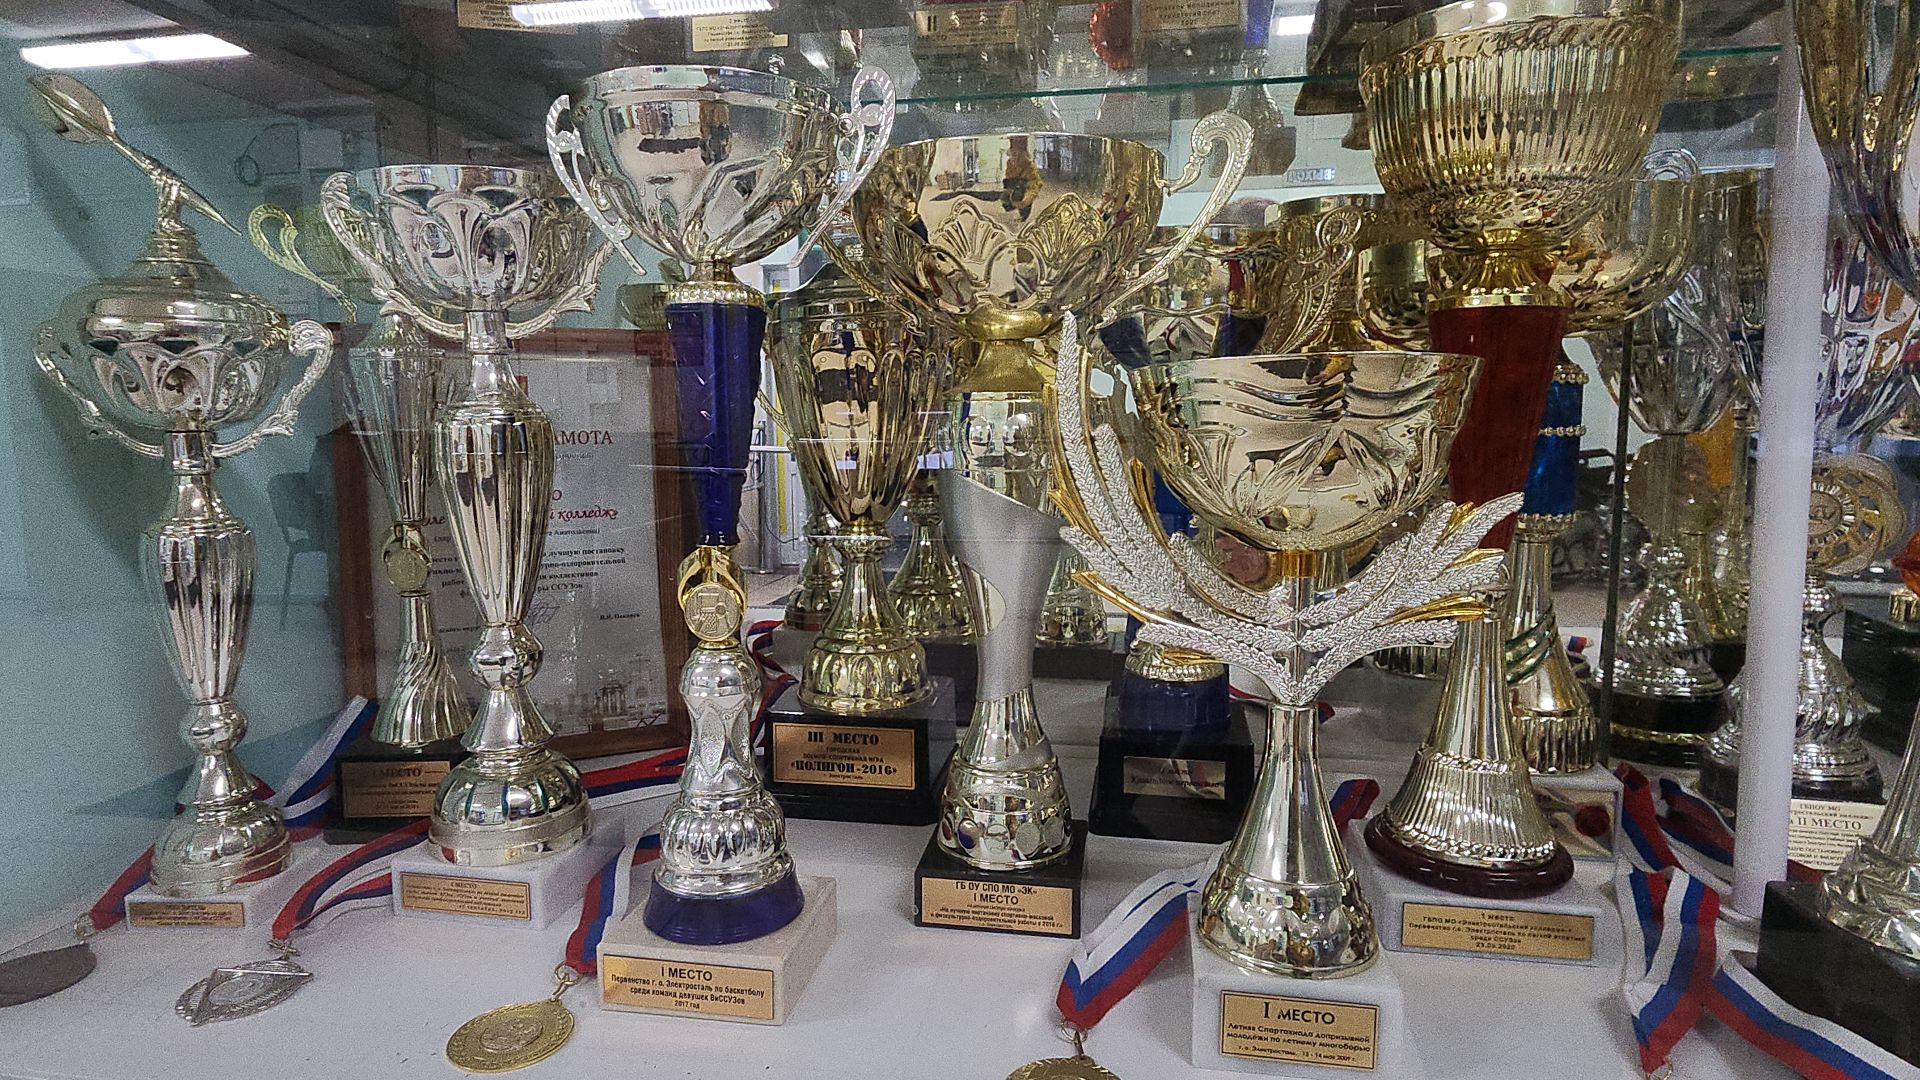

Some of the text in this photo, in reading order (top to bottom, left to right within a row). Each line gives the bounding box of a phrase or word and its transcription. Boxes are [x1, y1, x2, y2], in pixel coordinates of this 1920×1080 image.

[807, 731, 880, 746] III МЕСТО
[1798, 817, 1861, 830] II МЕСТО
[955, 881, 966, 890] ГБ
[968, 882, 980, 891] ОУ
[982, 883, 999, 892] СПО
[1001, 884, 1015, 894] МО
[980, 893, 1019, 905] МЕСТО
[668, 967, 713, 982] МЕСТО
[611, 974, 650, 985] Первенство
[665, 979, 713, 992] Электросталь
[724, 986, 765, 998] баскетболу
[630, 986, 650, 995] среди
[651, 989, 678, 998] команд
[678, 992, 709, 1002] девушек
[674, 1000, 700, 1010] 2017 год
[1263, 1001, 1335, 1025] I МЕСТО
[1227, 1022, 1370, 1043] Летняя Спартакиада допризывной
[1319, 1041, 1371, 1052] многоборью
